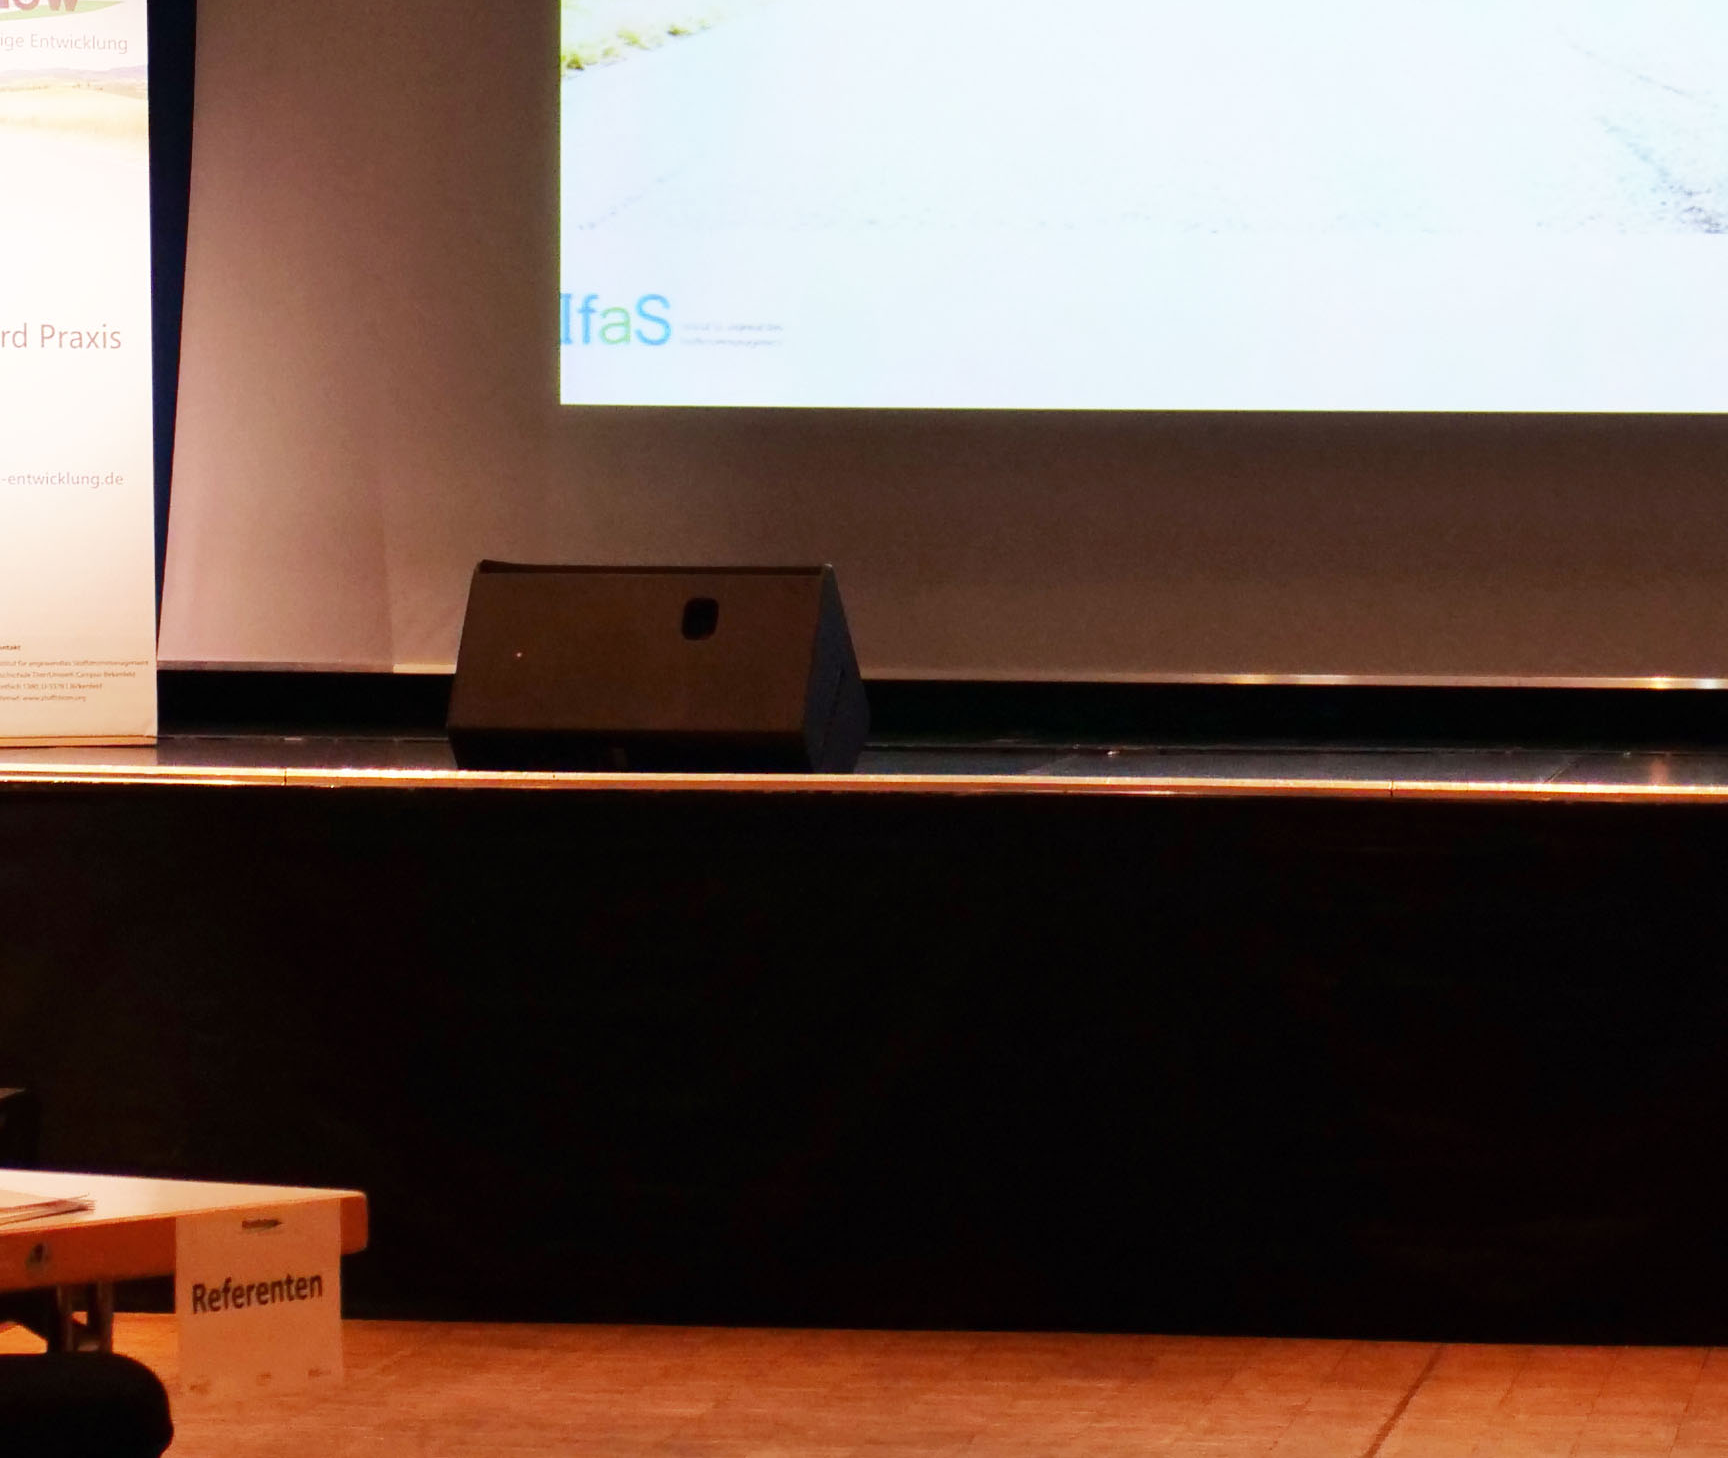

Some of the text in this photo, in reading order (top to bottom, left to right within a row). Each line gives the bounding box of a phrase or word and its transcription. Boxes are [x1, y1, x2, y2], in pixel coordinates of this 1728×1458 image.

[31, 34, 129, 54] Entwicklung
[40, 323, 123, 350] Praxis
[560, 293, 672, 346] IfaS
[191, 1273, 323, 1315] Referenten
